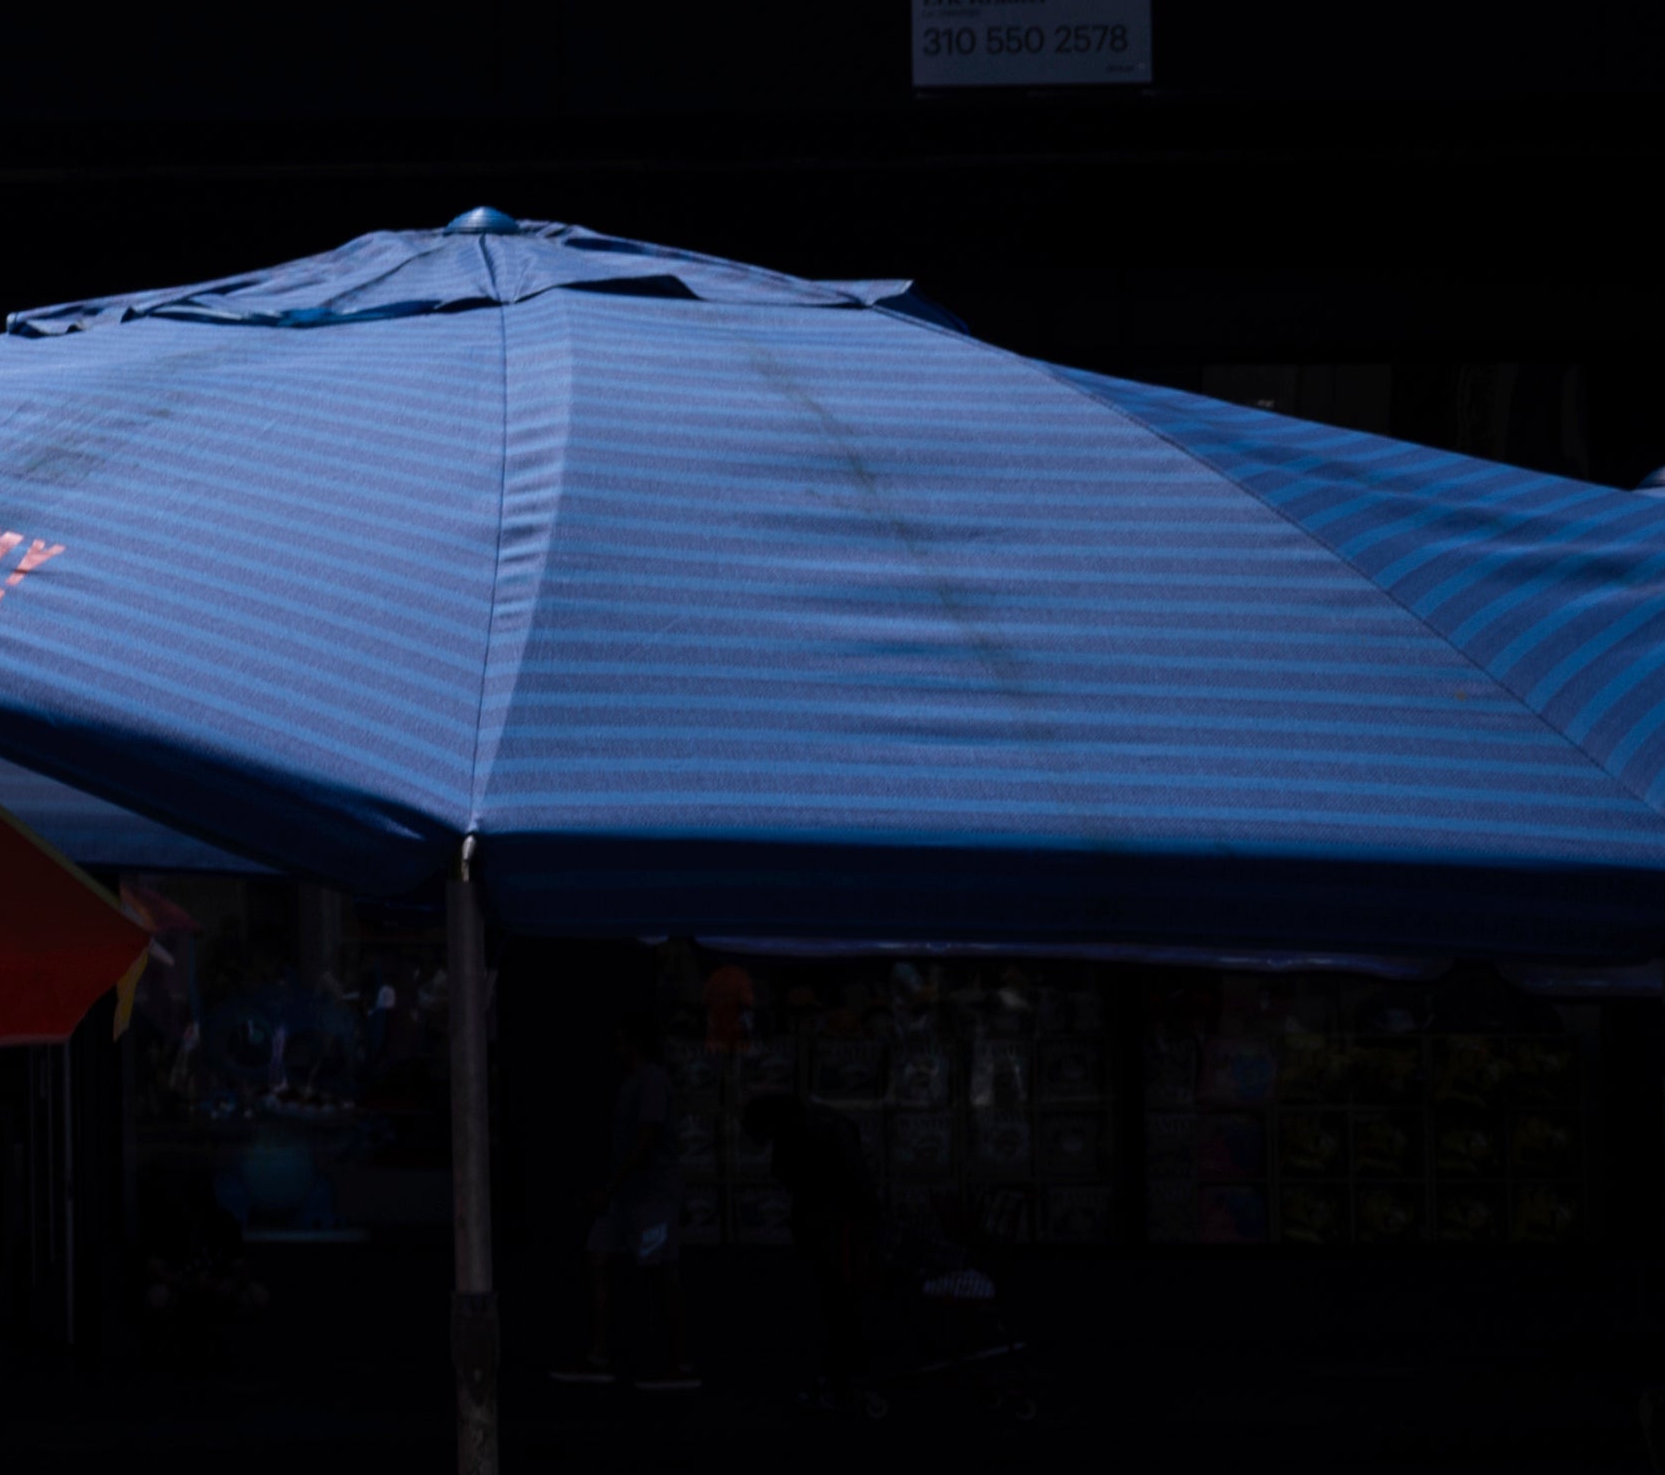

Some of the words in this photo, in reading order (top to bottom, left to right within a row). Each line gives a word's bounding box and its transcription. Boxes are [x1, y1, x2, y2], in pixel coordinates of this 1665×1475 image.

[923, 27, 977, 56] 310
[985, 26, 1045, 55] 550
[1054, 24, 1129, 53] 2578
